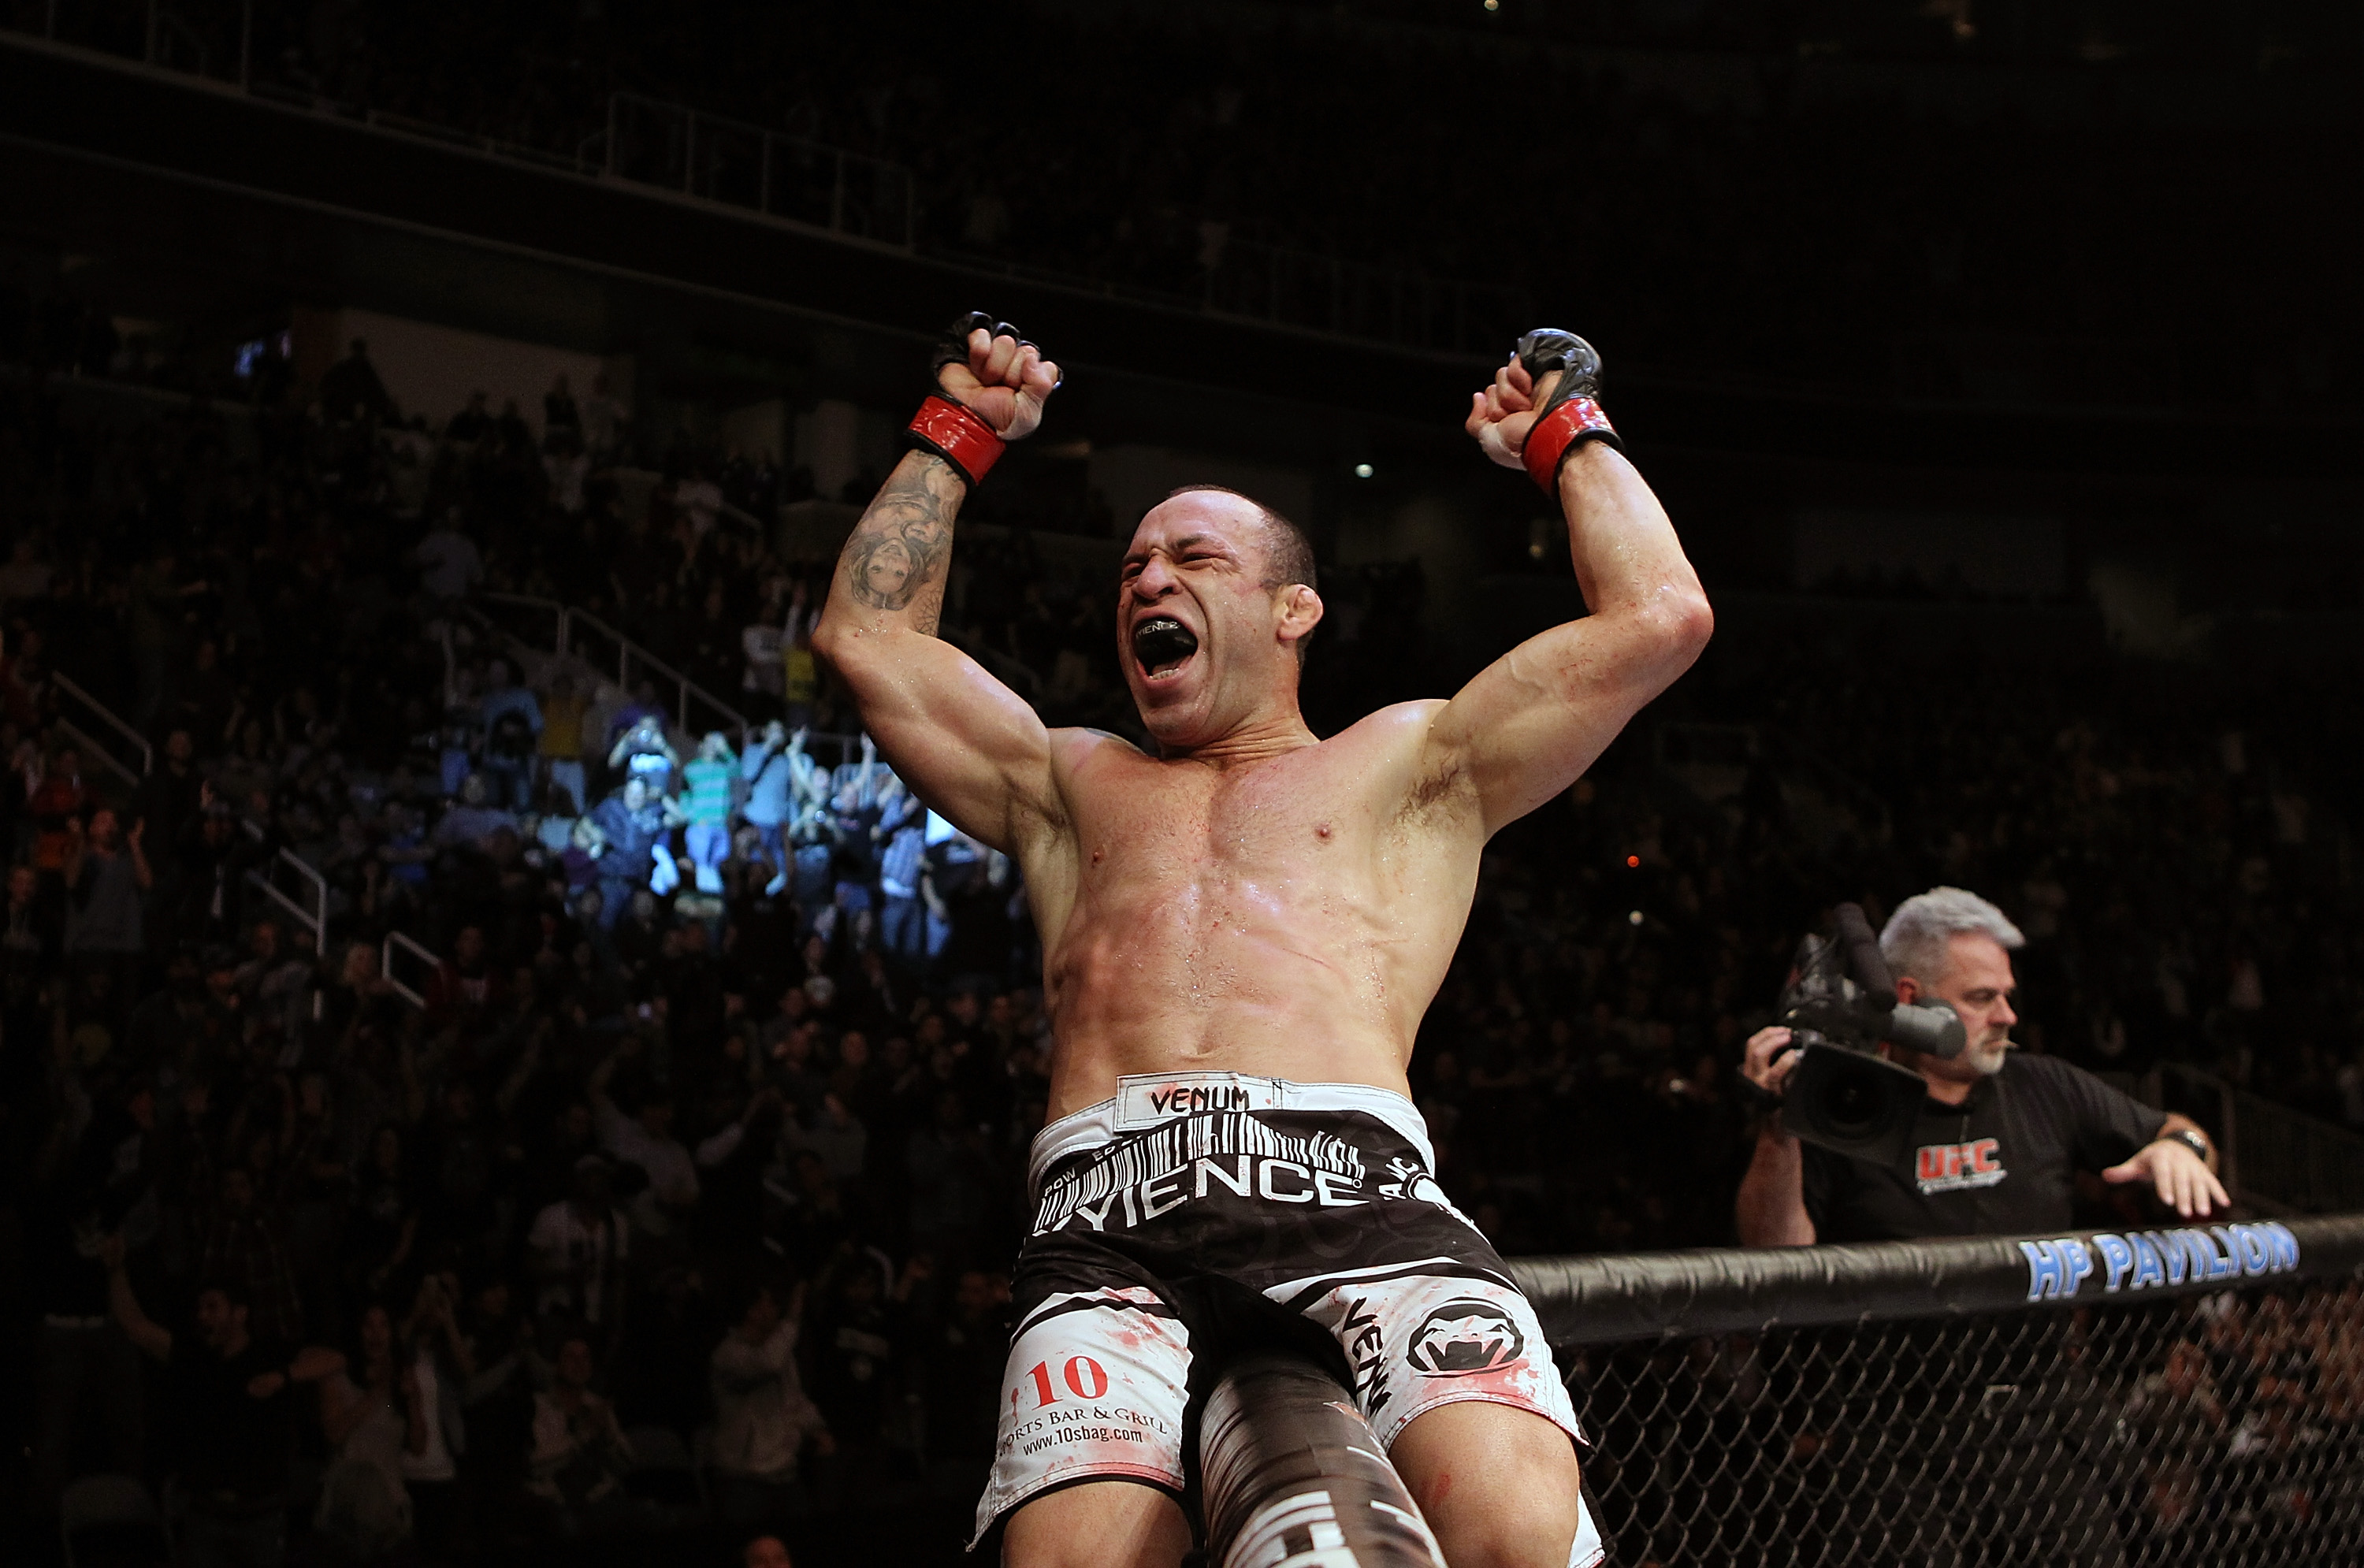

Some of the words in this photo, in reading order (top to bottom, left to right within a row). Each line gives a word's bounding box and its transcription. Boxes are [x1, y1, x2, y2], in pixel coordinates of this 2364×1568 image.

[1150, 1085, 1250, 1115] VENUM
[1915, 1138, 2002, 1180] UFC
[2018, 1238, 2094, 1302] HP
[2092, 1221, 2300, 1293] PAVILION
[1025, 1355, 1109, 1410] 10
[1048, 1407, 1089, 1426] BAR
[1093, 1406, 1109, 1419] &
[1114, 1407, 1168, 1435] GRILL
[1023, 1425, 1143, 1456] www.10sbag.com
